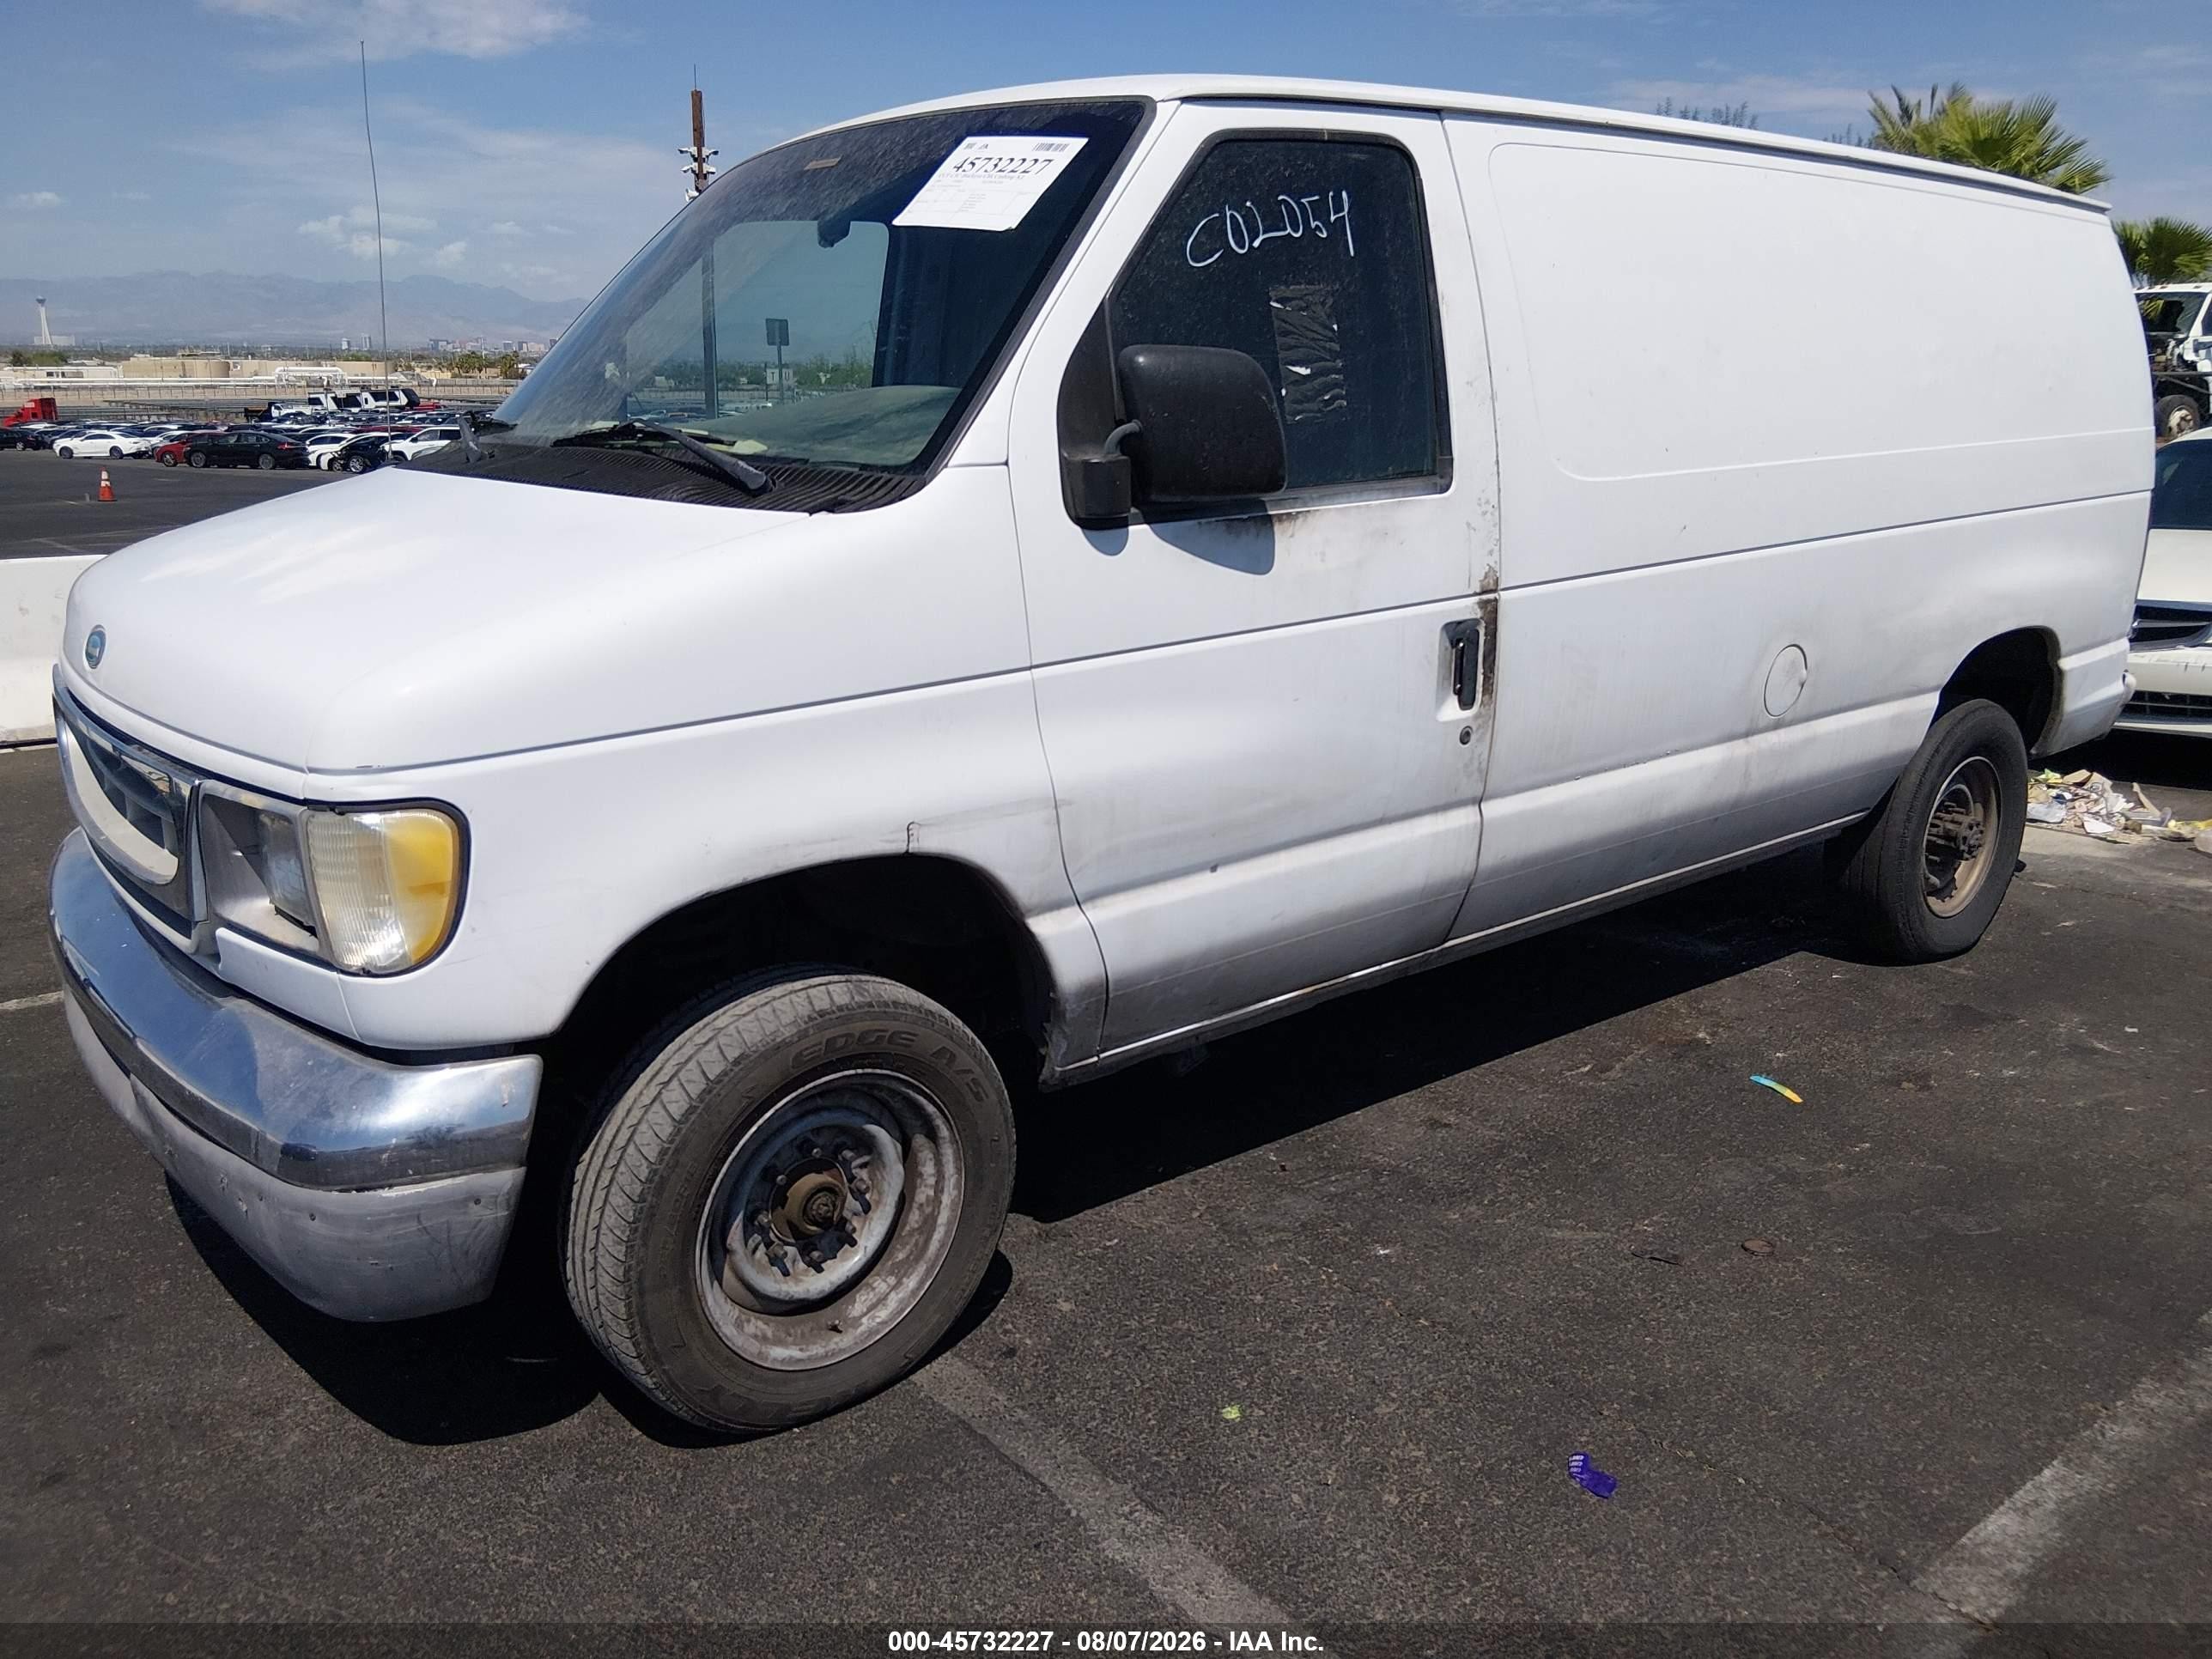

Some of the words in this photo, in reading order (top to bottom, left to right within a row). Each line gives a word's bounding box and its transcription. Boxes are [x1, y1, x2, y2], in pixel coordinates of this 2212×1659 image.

[952, 156, 1056, 175] 45732227
[790, 1028, 920, 1070] EDGE
[929, 1045, 991, 1103] A/S
